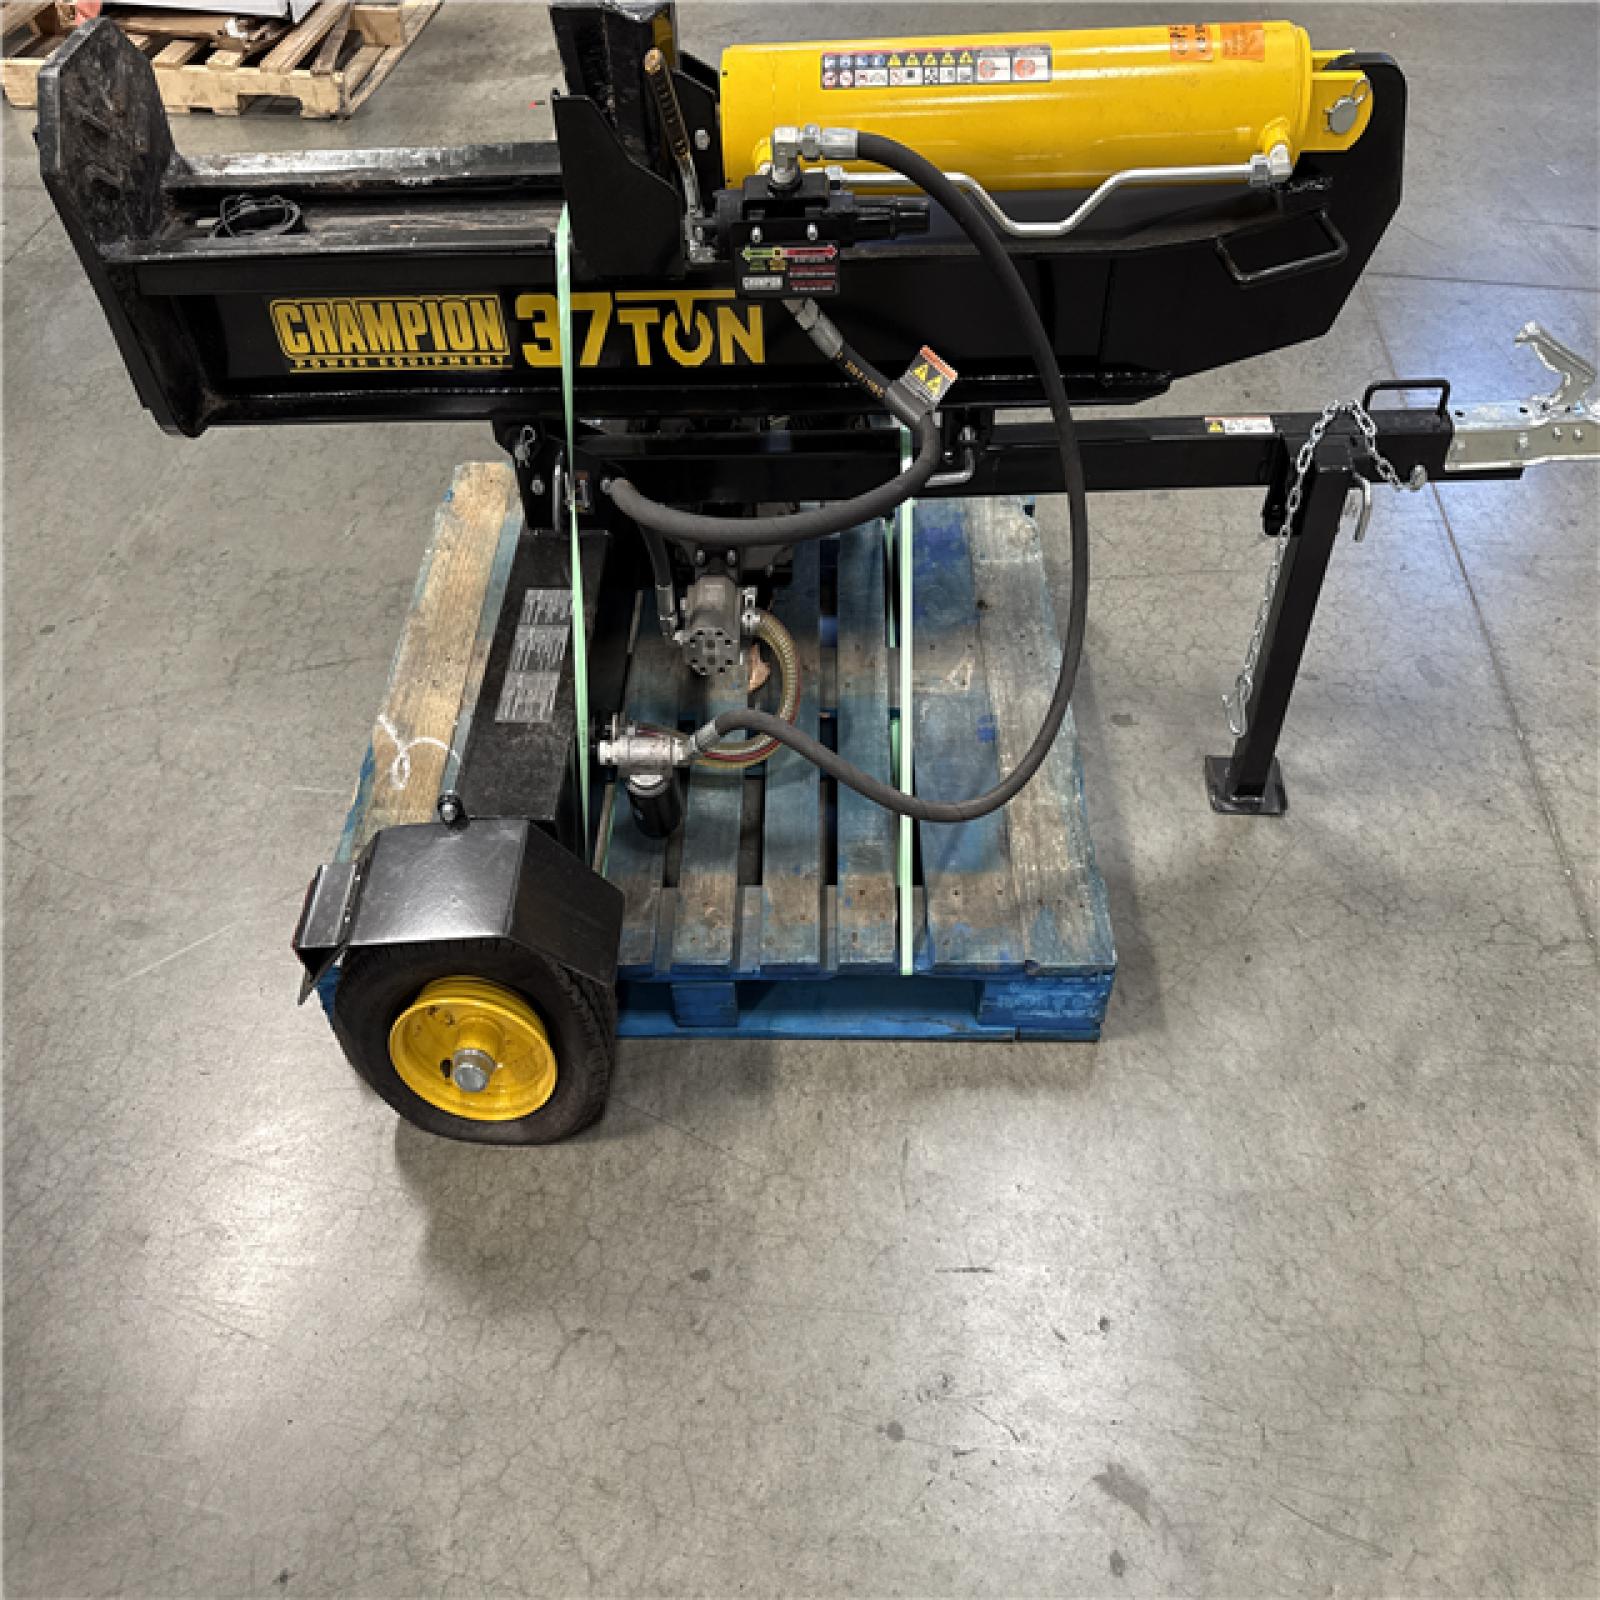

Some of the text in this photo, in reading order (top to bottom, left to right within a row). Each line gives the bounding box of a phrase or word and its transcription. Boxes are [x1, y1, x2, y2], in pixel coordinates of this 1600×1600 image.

[274, 300, 506, 354] CHAMPION
[515, 292, 765, 367] 37 TON
